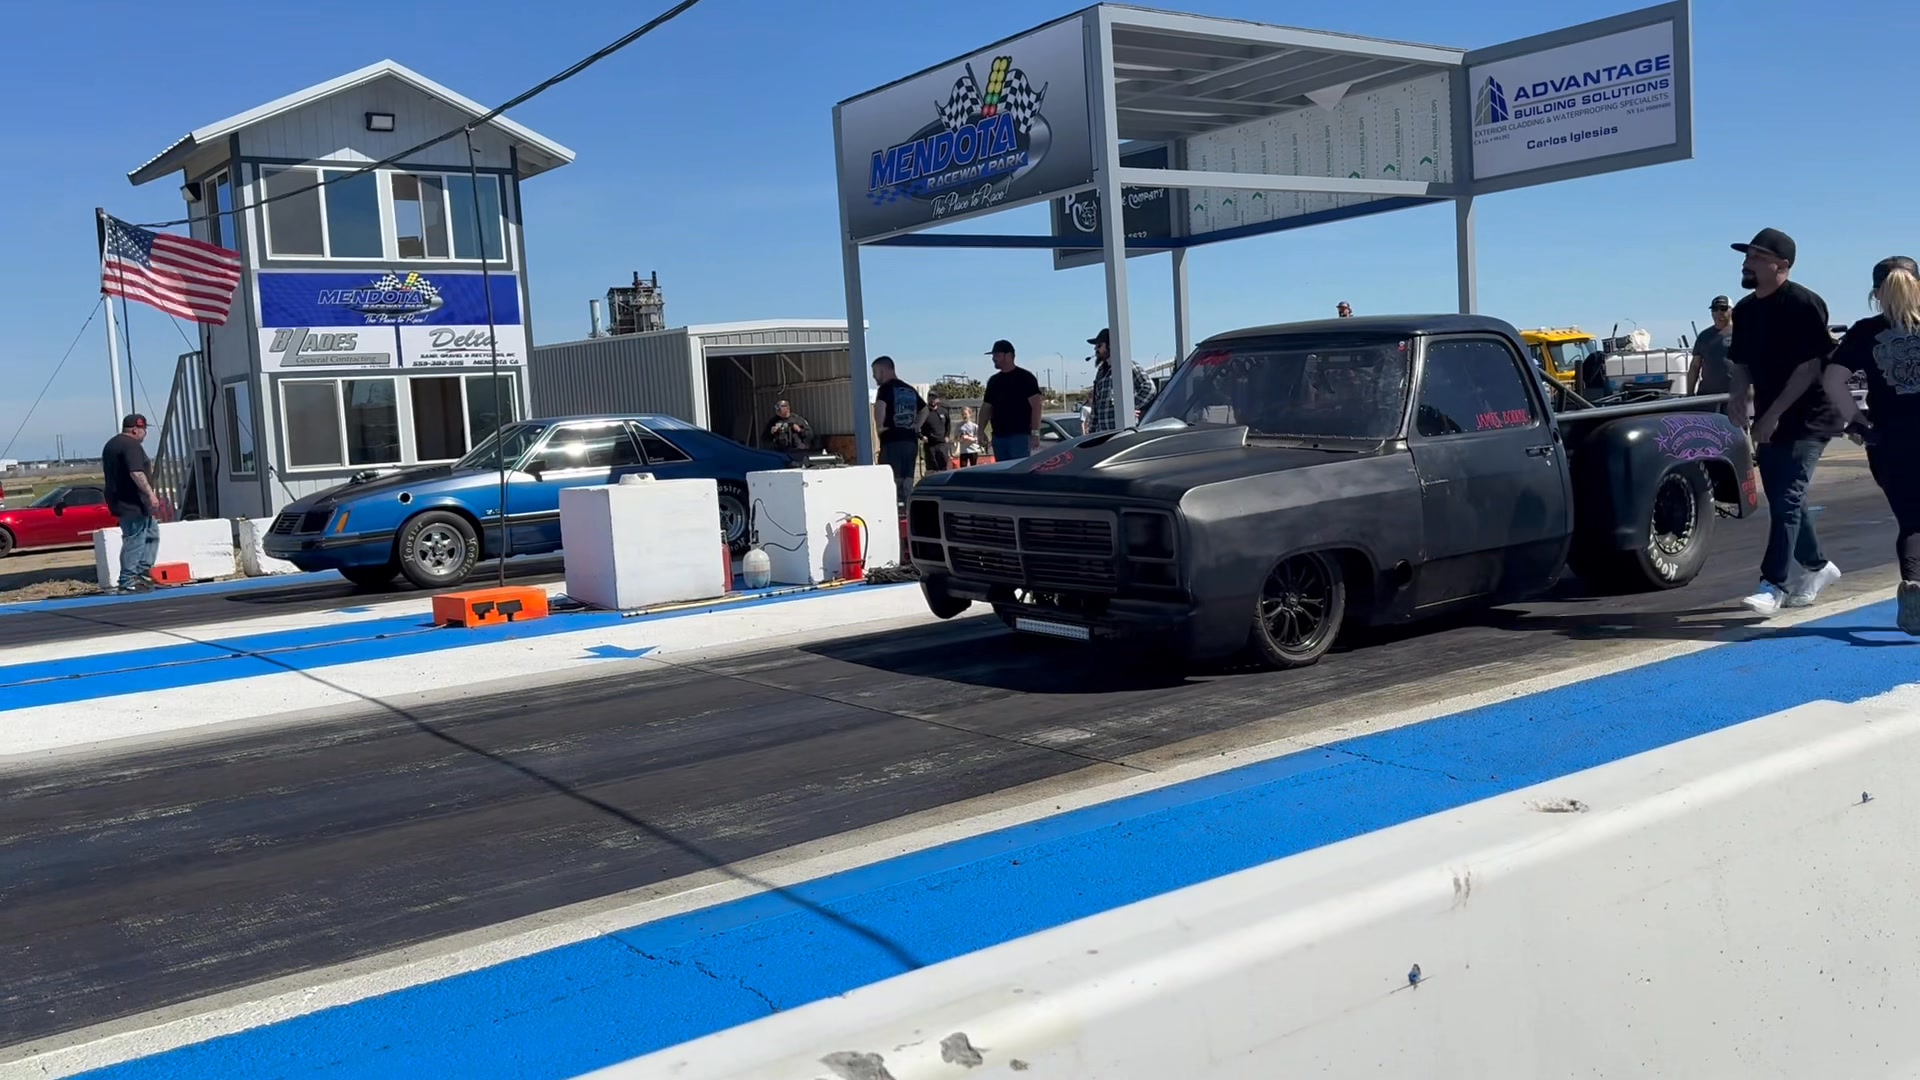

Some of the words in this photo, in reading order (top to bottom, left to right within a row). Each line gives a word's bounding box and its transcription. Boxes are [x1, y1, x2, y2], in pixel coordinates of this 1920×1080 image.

[1514, 54, 1670, 102] ADVANTAGE
[1474, 125, 1507, 138] EXTERIOR
[1508, 117, 1545, 131] CLADDING
[1546, 115, 1552, 123] &
[1552, 102, 1618, 122] WATERPROOFING
[1619, 92, 1669, 109] SPECIALISTS
[1514, 98, 1576, 119] BUILDING
[1582, 78, 1669, 105] SOLUTIONS
[869, 111, 1017, 192] MENDOTA
[1526, 136, 1567, 150] Carlos
[1570, 125, 1618, 143] Iglesias
[926, 162, 986, 190] RACEWAY
[987, 151, 1026, 173] PARK
[930, 196, 946, 218] The
[945, 192, 969, 214] Place
[970, 194, 979, 206] to
[977, 178, 1011, 206] Race!
[317, 289, 424, 304] MENDOTA
[364, 314, 376, 324] The
[375, 313, 396, 324] Place
[397, 315, 404, 323] to
[402, 313, 429, 325] Race!
[269, 328, 359, 360] BLADES
[429, 328, 499, 348] Delta
[296, 355, 329, 364] General
[330, 355, 377, 364] Contracting
